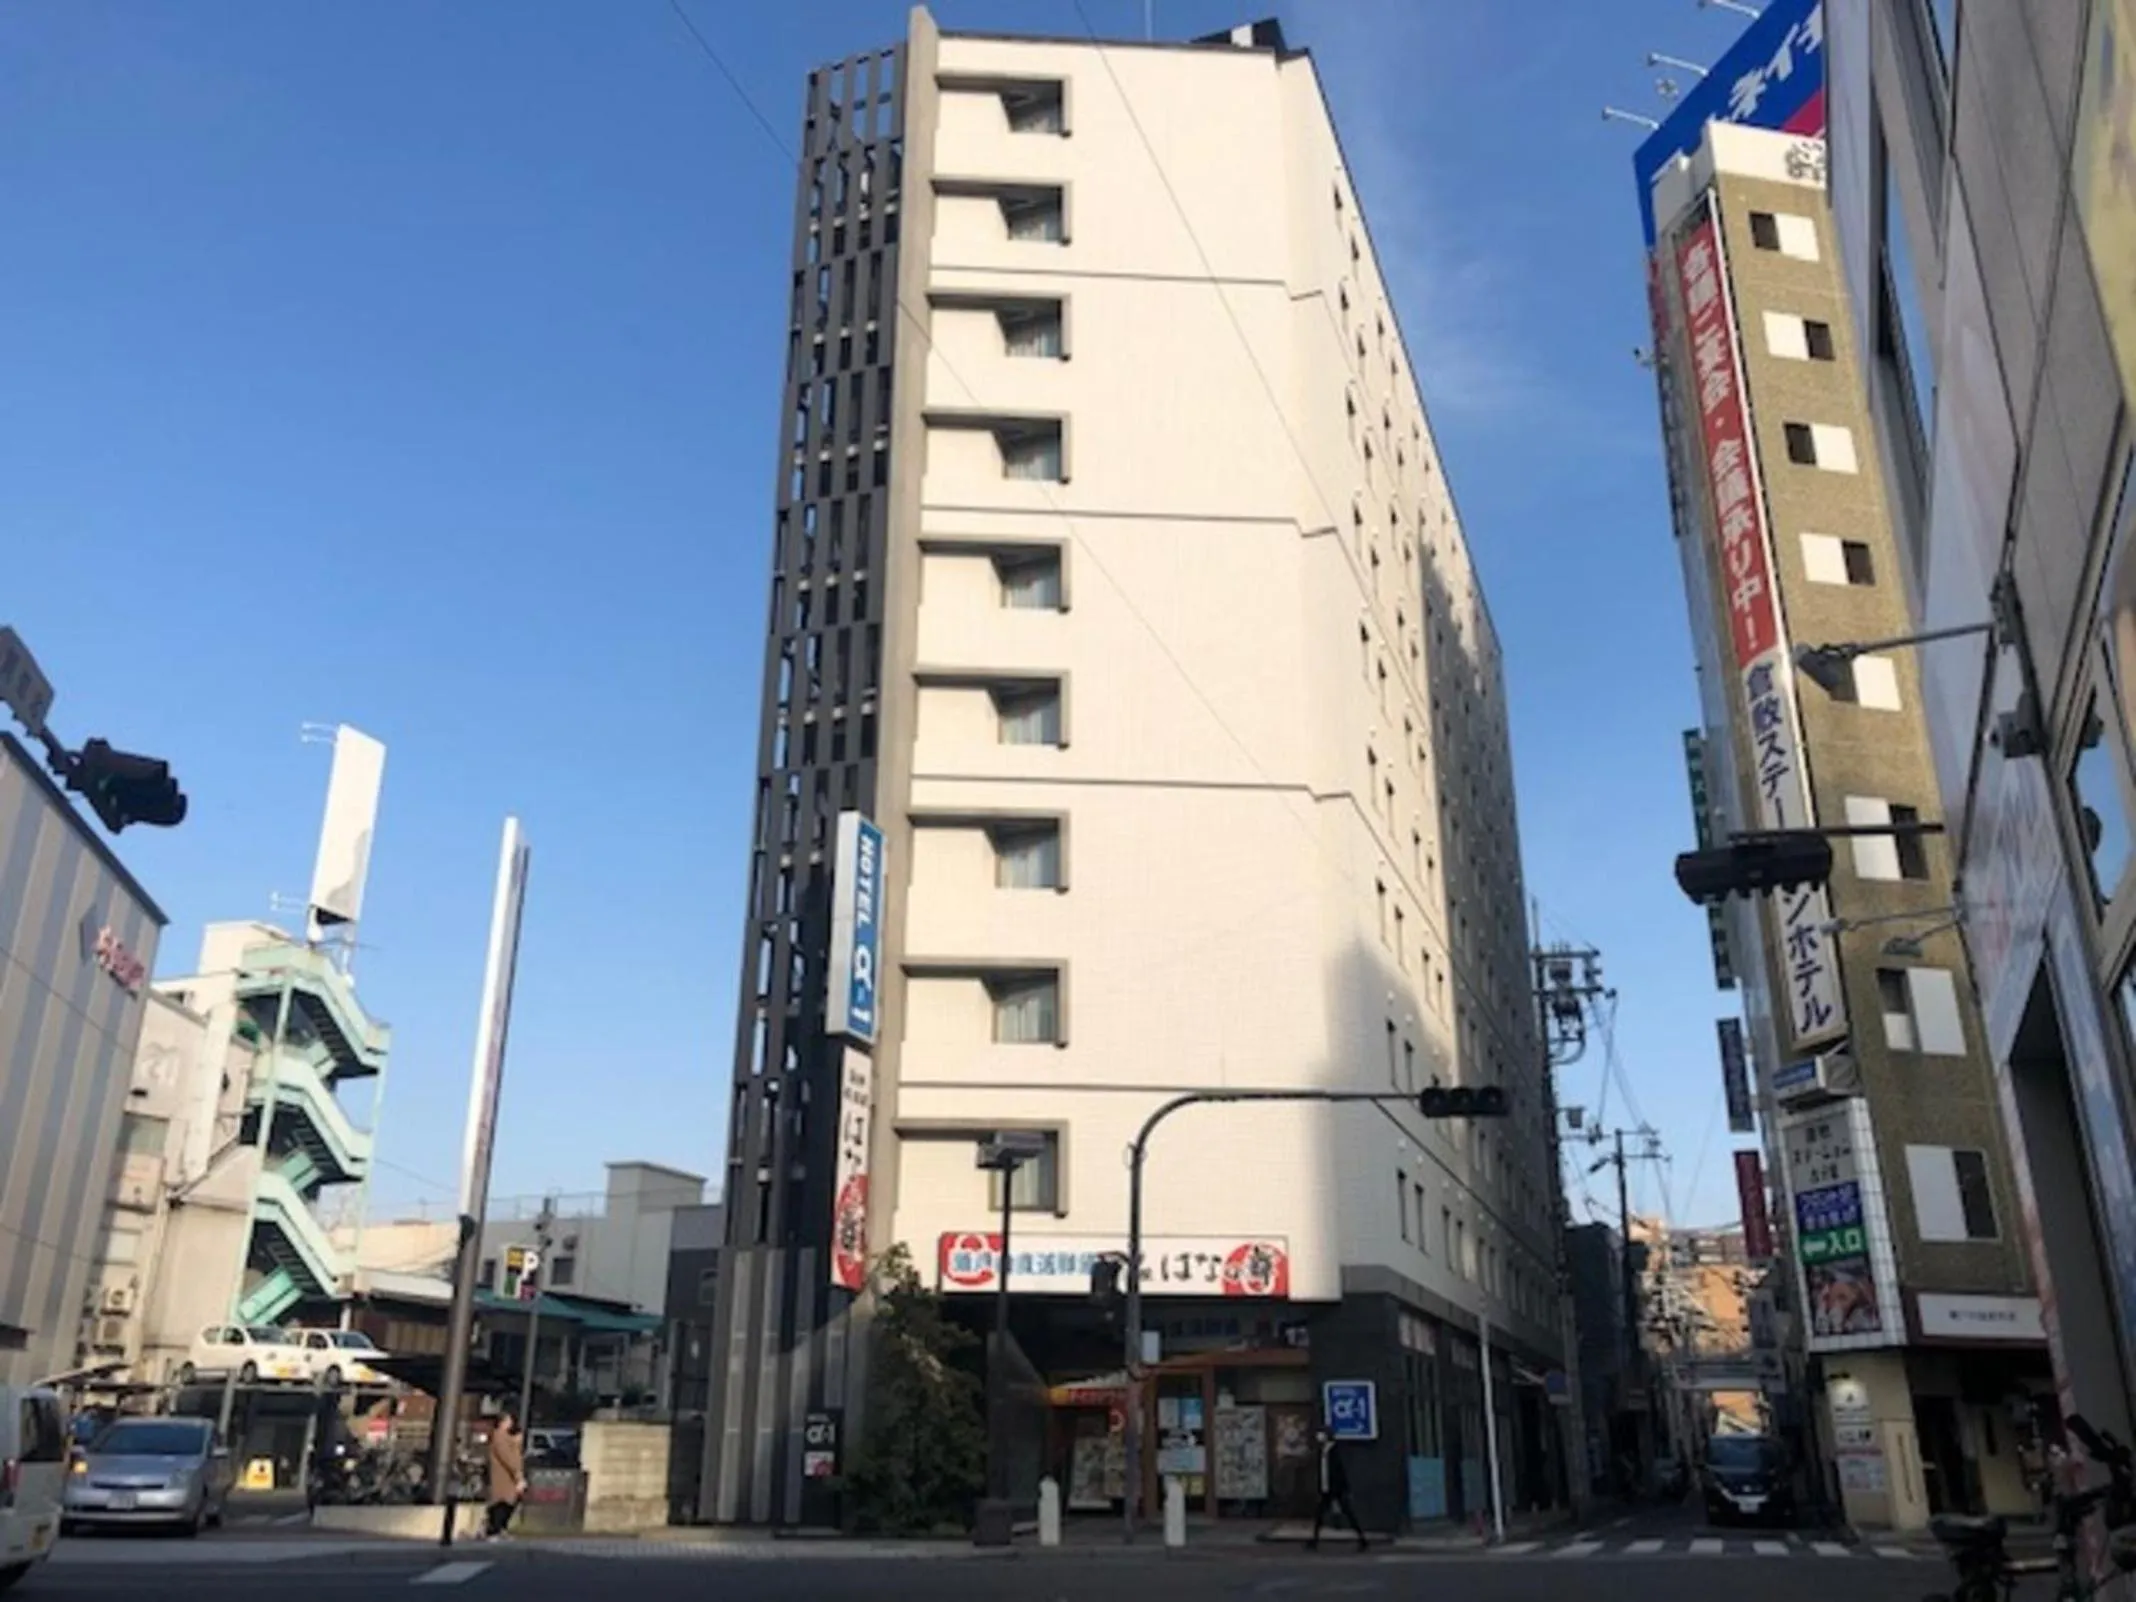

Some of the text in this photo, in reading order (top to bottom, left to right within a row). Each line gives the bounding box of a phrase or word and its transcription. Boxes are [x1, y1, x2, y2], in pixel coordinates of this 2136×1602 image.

[857, 835, 875, 928] HOTEL
[1748, 653, 1832, 1033] 倉敷ステーンホテル
[1829, 1228, 1862, 1254] 入口
